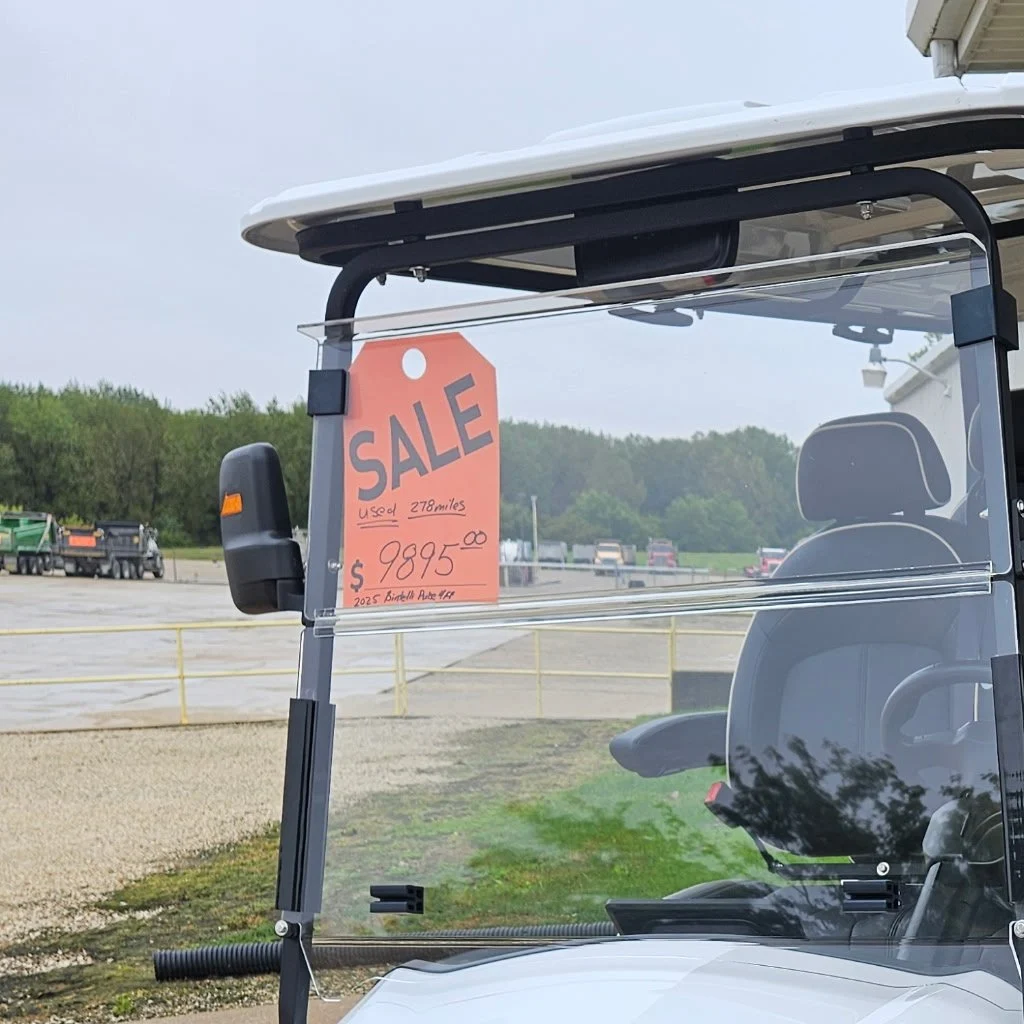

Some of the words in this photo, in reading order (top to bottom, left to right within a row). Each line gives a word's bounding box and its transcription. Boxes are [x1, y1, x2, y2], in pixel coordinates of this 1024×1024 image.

[349, 373, 494, 501] SALE
[378, 540, 461, 584] 9895
[353, 593, 381, 608] 2025
